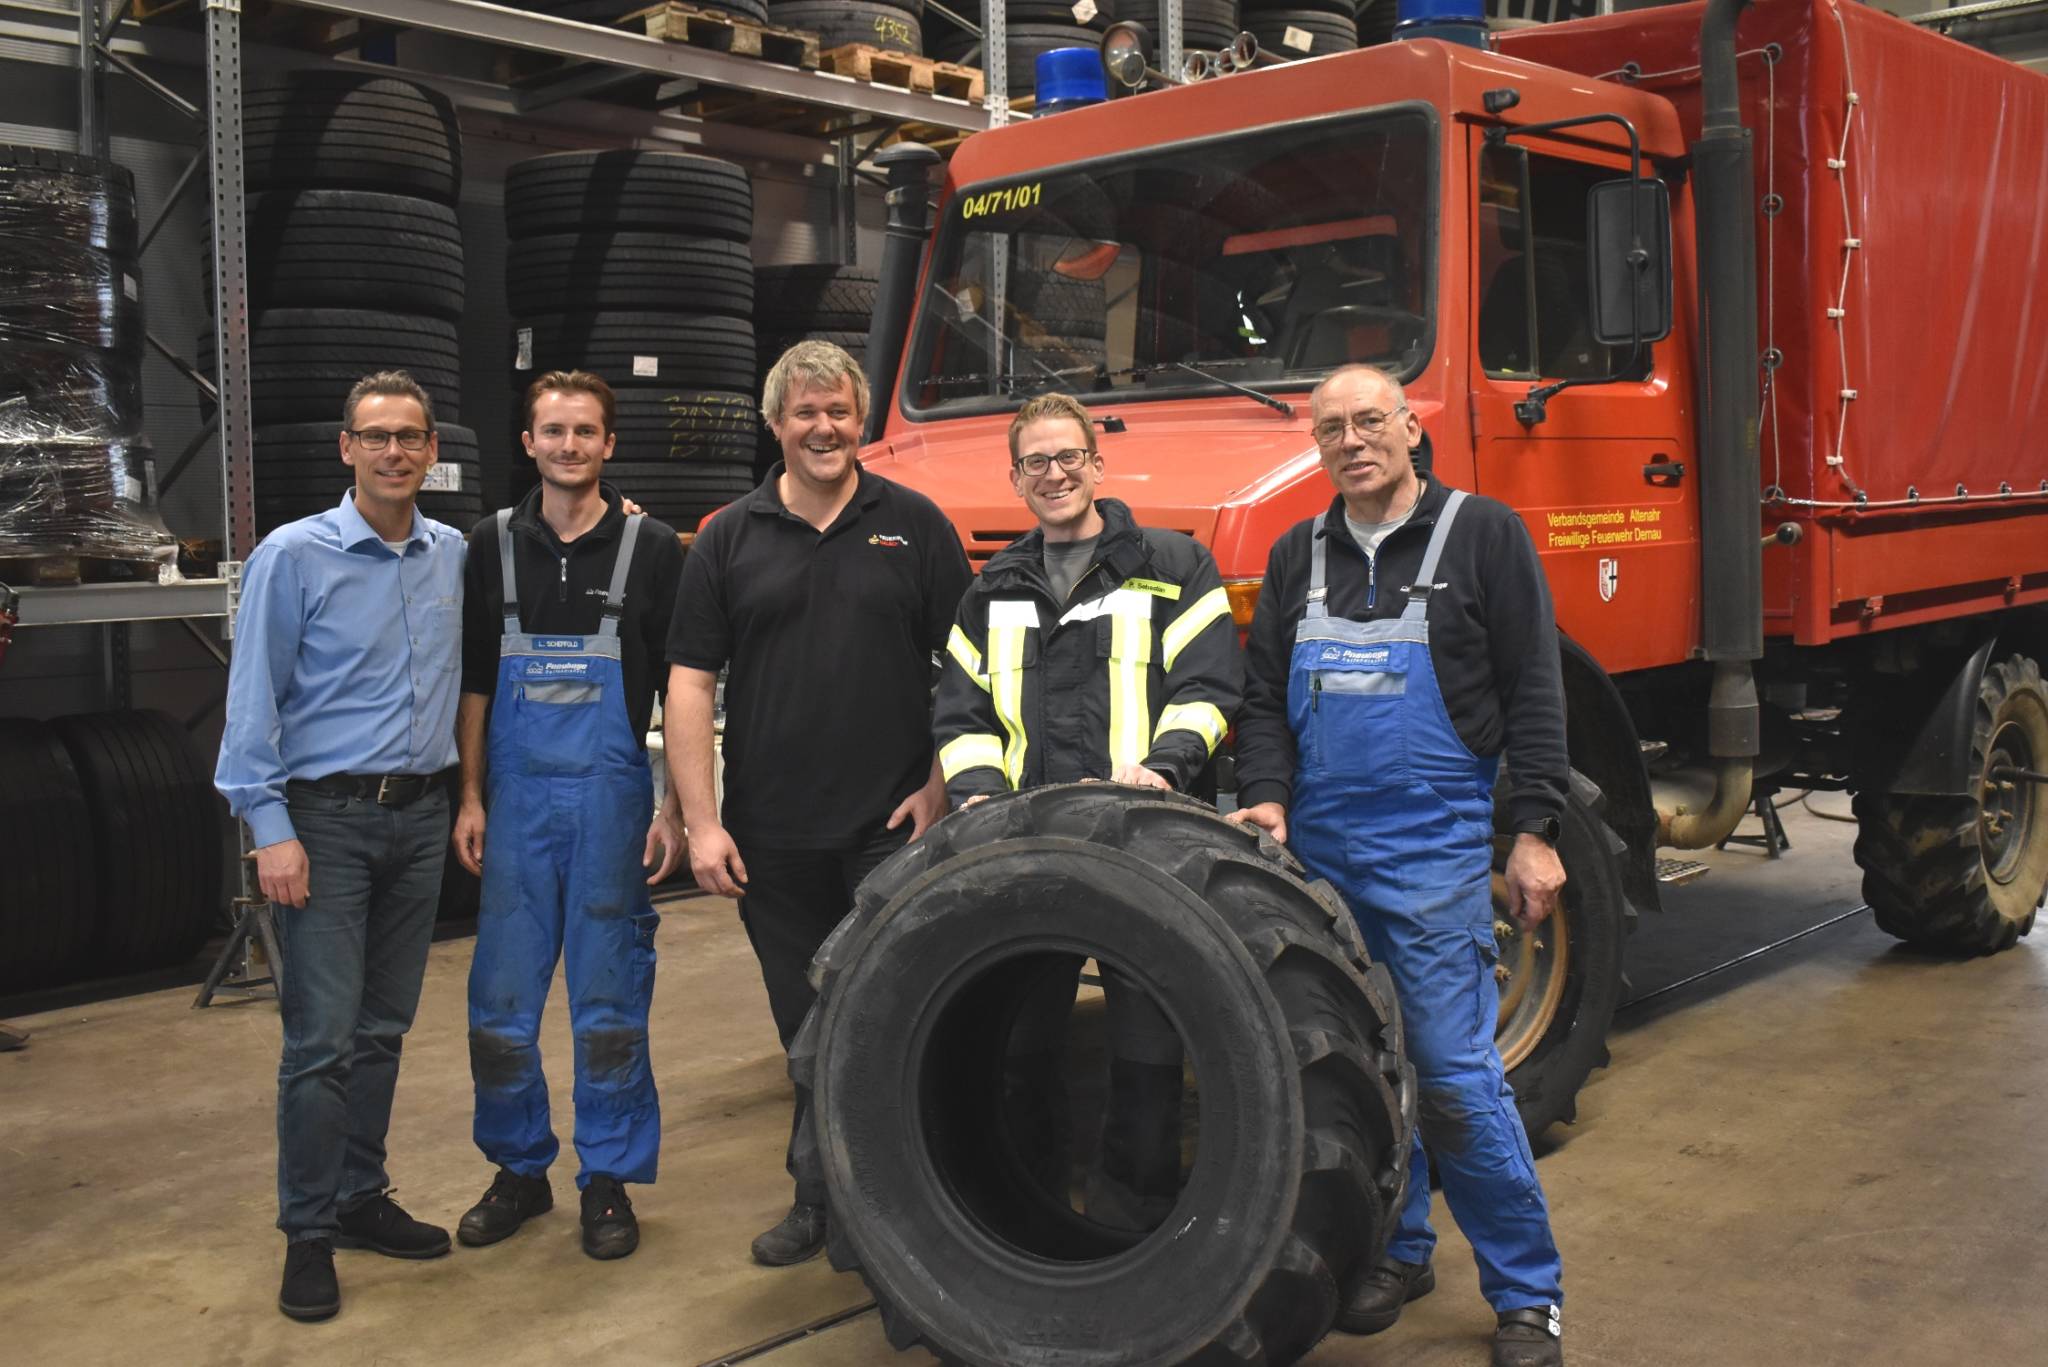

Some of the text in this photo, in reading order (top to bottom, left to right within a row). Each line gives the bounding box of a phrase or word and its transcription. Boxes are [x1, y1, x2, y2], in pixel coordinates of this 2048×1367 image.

[963, 182, 1041, 219] 04/71/01
[1547, 508, 1661, 528] Verbandsgemeinde Altenahr
[1549, 531, 1590, 549] Freiwillige
[1592, 528, 1633, 544] Feuerwehr
